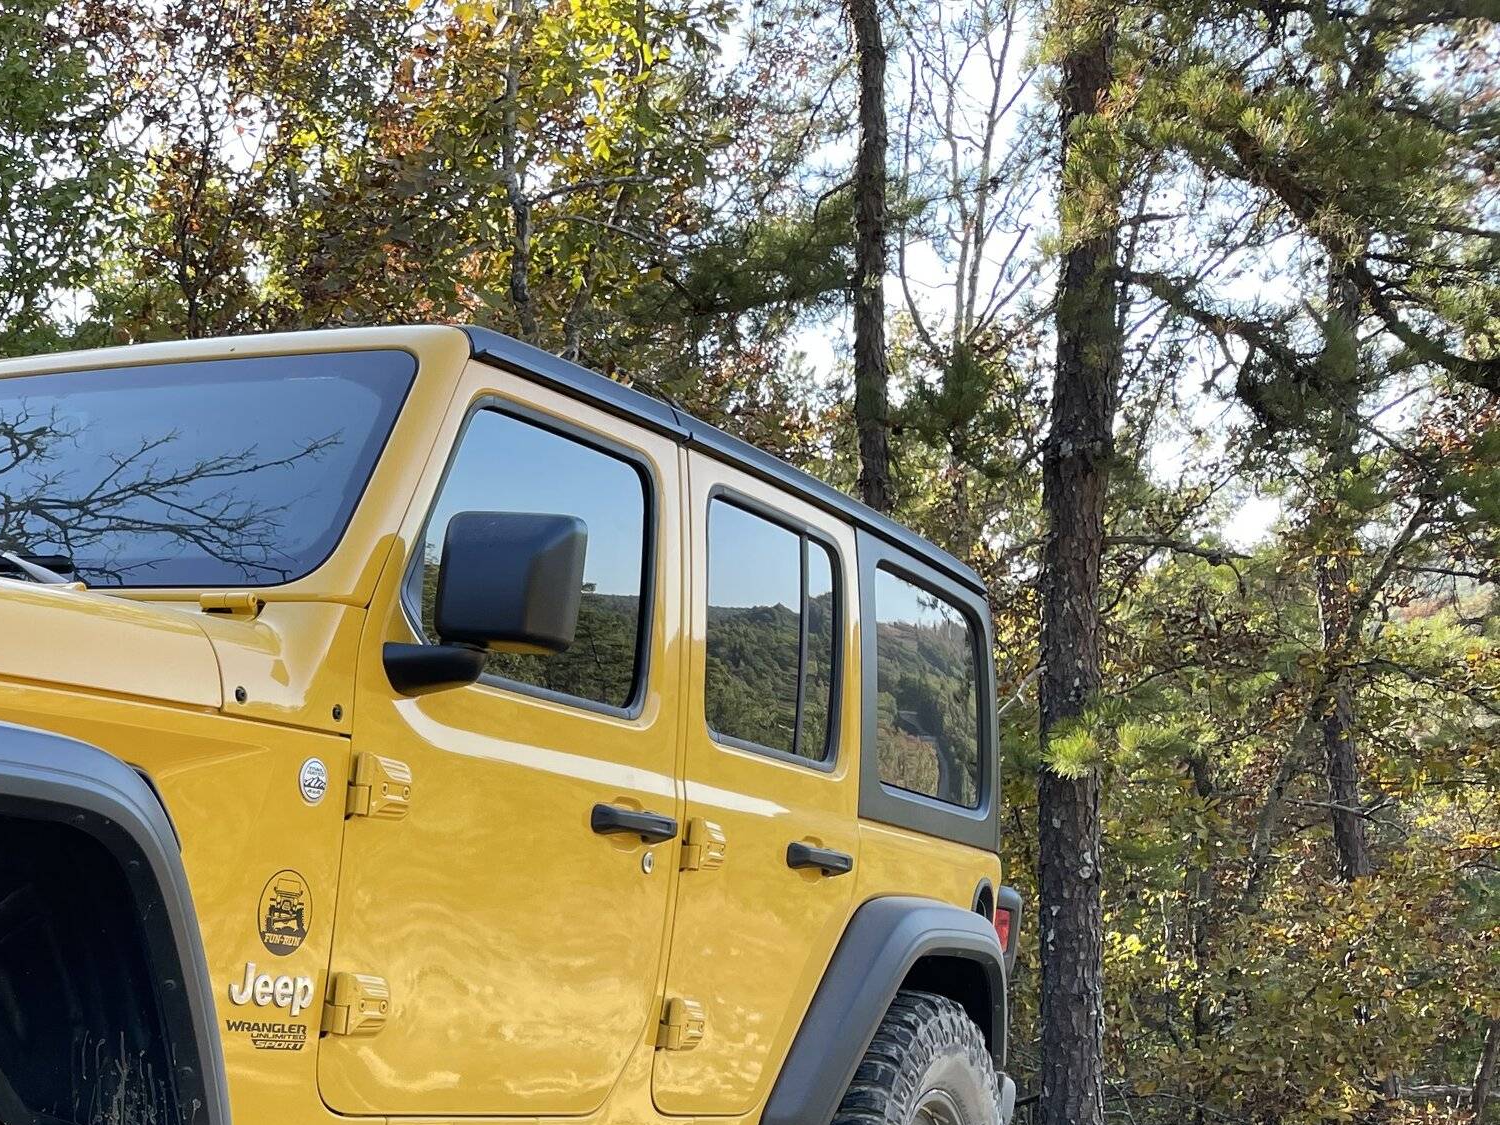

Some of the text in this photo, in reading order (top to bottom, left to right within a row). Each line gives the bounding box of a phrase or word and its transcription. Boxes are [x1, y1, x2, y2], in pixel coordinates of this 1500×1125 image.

[229, 961, 315, 1017] Jeep
[226, 1019, 307, 1034] WRANGLER
[251, 1032, 307, 1041] UNLIMITED
[254, 1040, 305, 1050] SPORT
